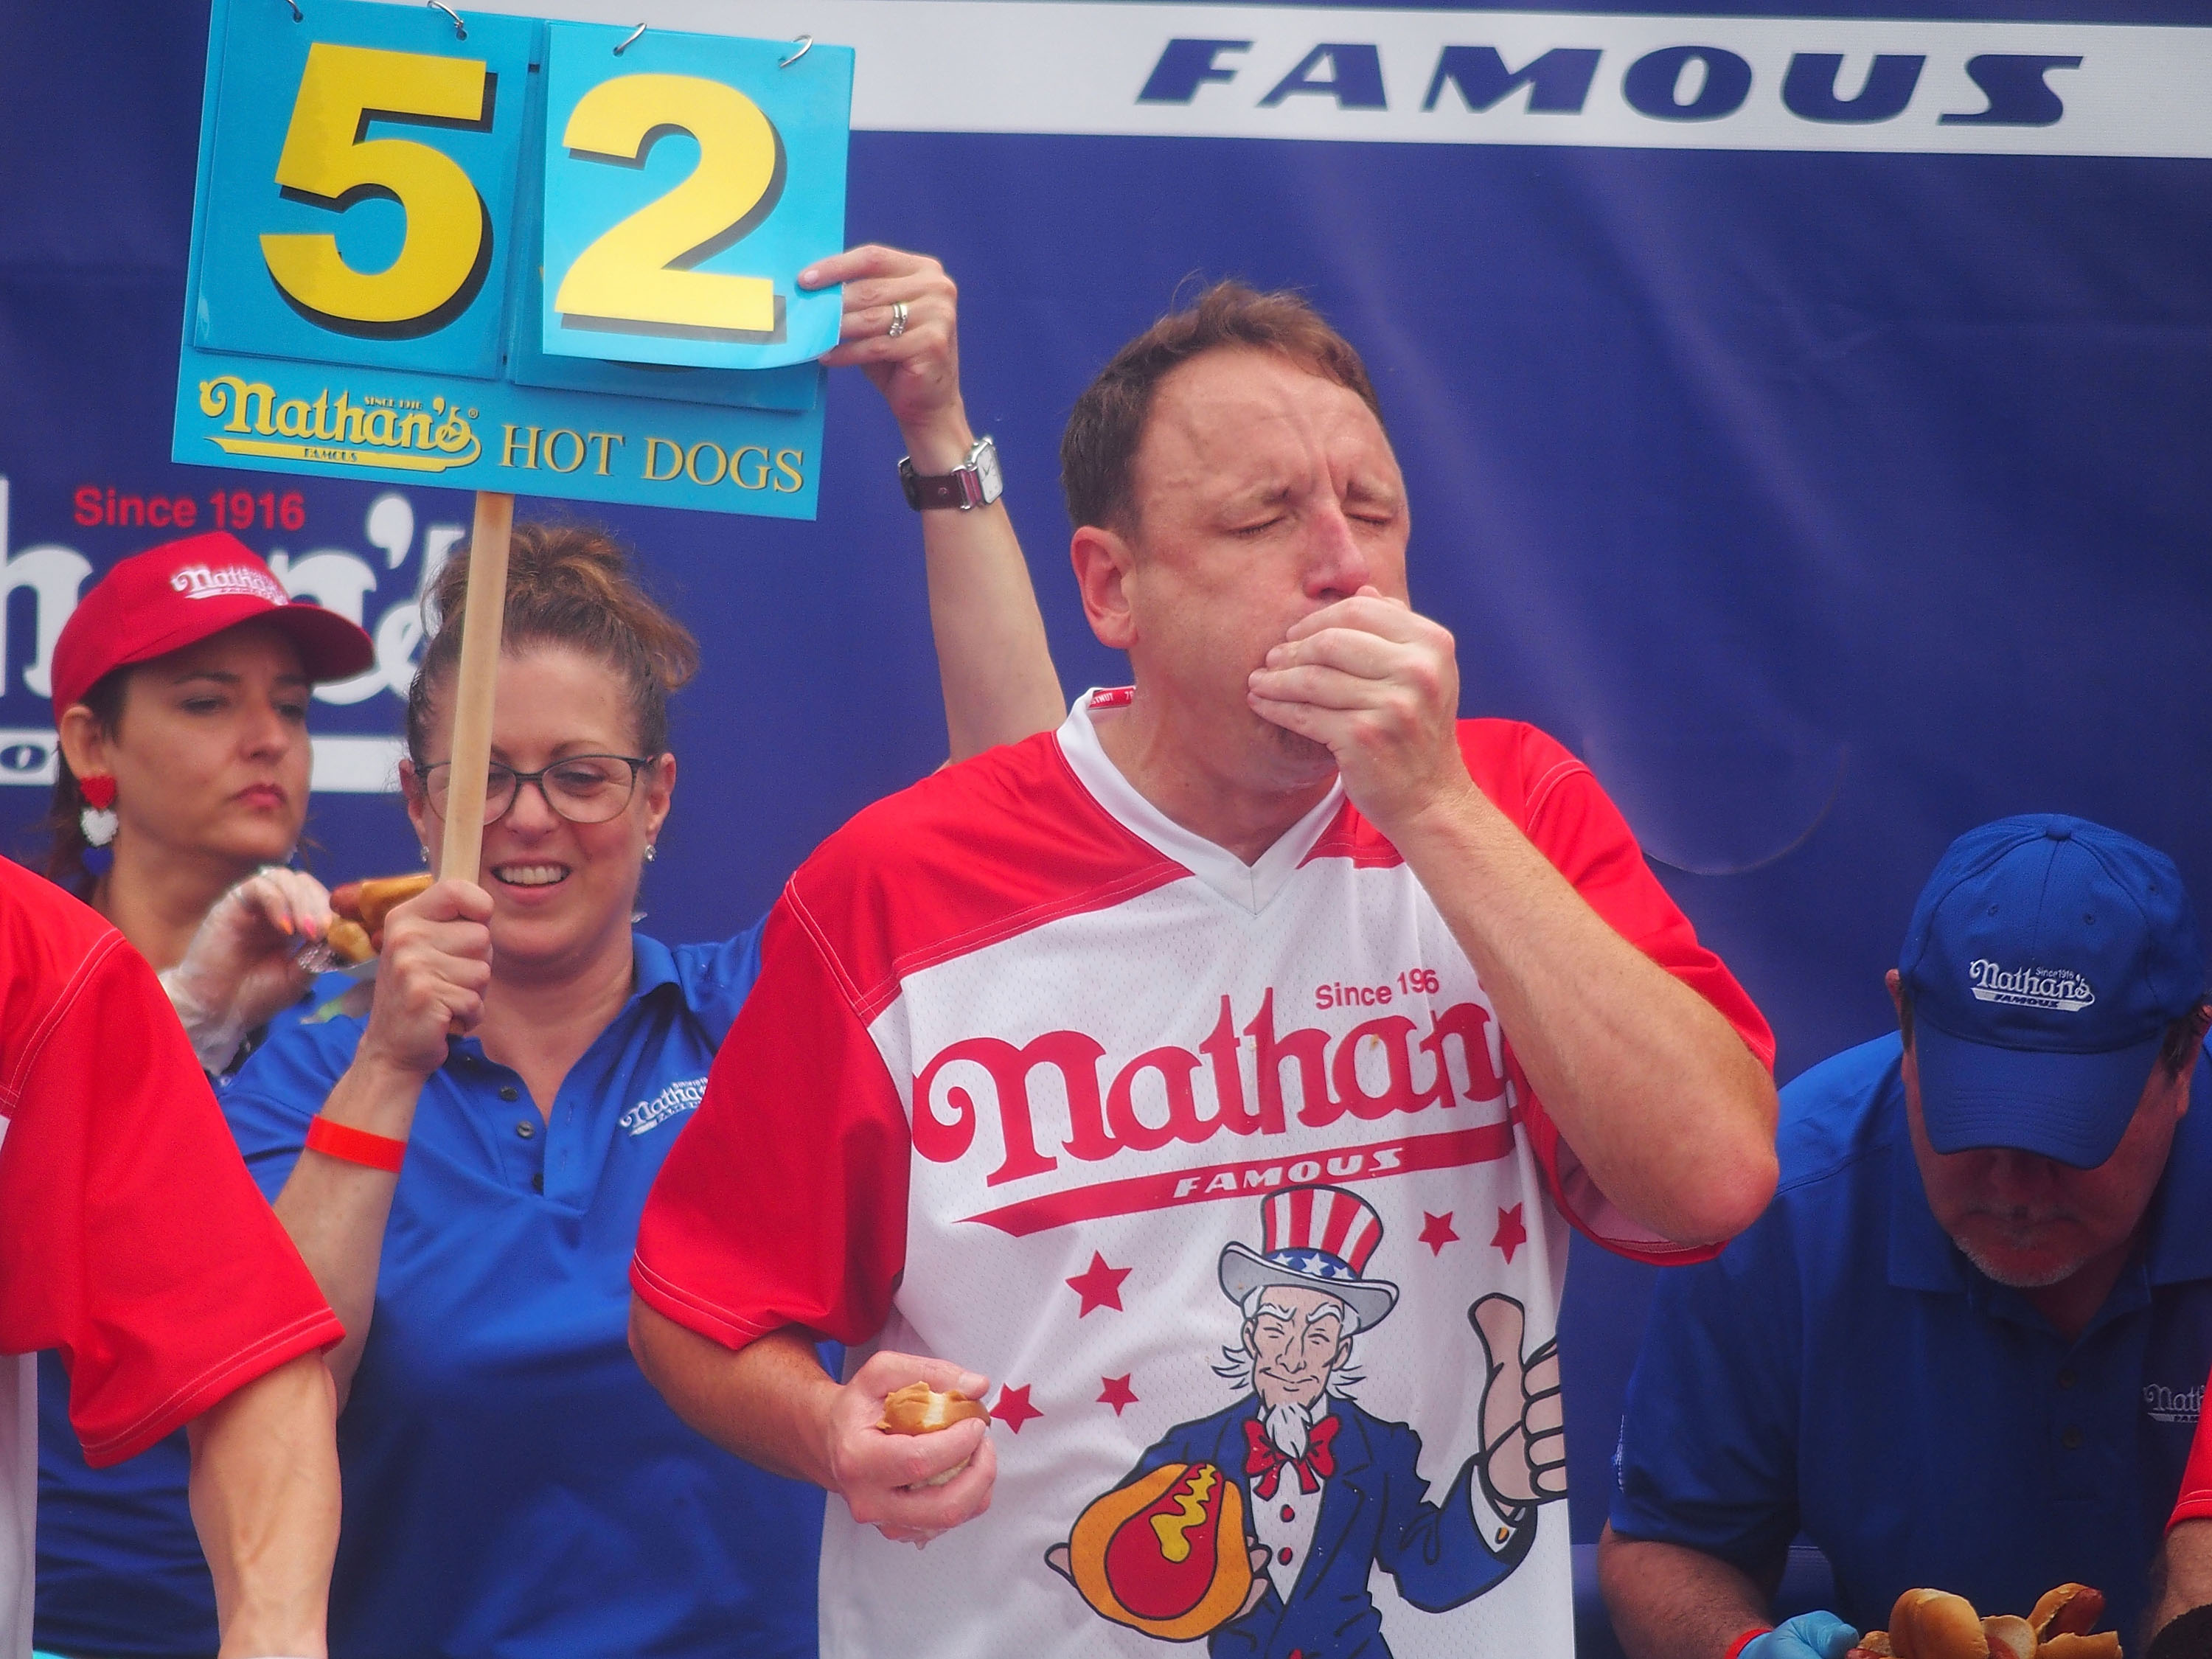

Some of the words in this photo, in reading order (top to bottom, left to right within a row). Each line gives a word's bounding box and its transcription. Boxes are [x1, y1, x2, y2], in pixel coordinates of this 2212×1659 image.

[1136, 38, 2084, 127] FAMOUS
[260, 42, 786, 344] 52
[198, 375, 472, 453] Nathan's
[305, 448, 358, 462] FAMOUS
[498, 423, 625, 476] HOT
[641, 437, 804, 493] DOGS
[74, 485, 196, 528] Since
[209, 487, 306, 531] 1916
[1315, 981, 1393, 1010] Since
[1969, 959, 2091, 1000] Nathan's
[913, 986, 1506, 1187] Nathan
[1173, 1147, 1404, 1198] FAMOUS
